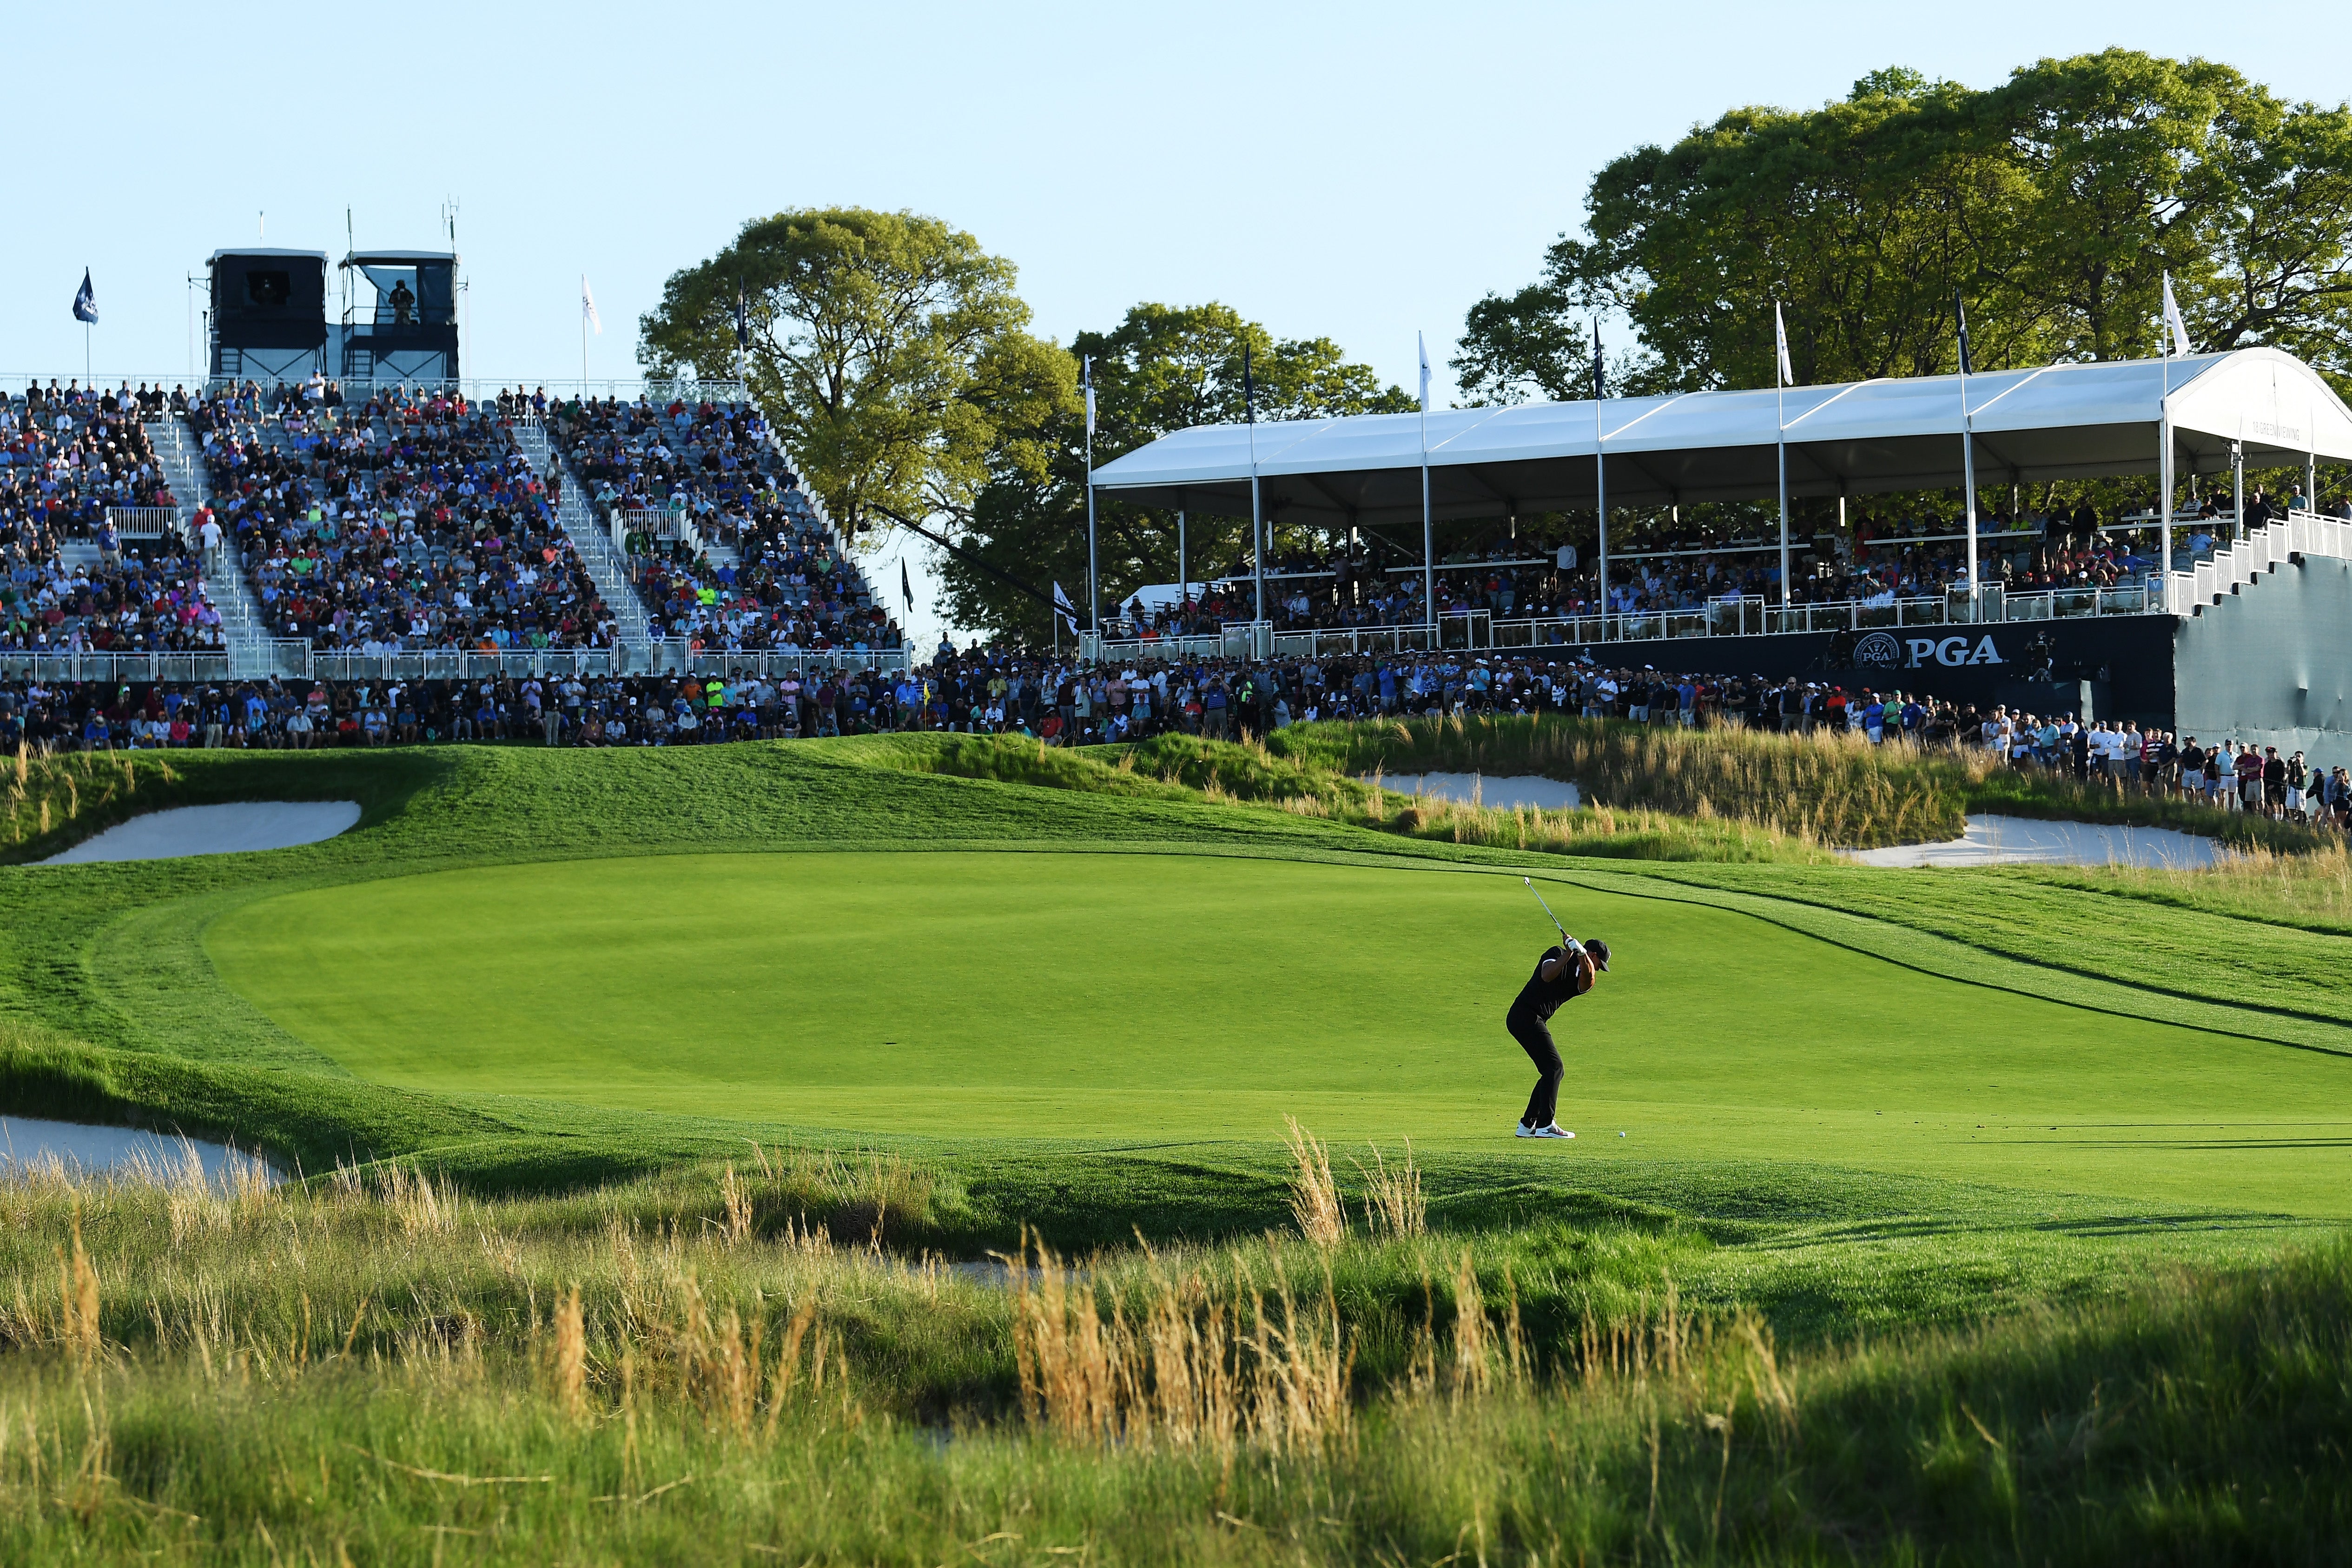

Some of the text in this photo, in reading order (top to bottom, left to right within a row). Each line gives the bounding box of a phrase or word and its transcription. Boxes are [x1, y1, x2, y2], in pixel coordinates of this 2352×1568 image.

[2260, 422, 2276, 436] GREEN
[2277, 425, 2299, 441] VIEWING
[1862, 652, 1890, 662] PGA
[1904, 635, 2003, 668] PGA
